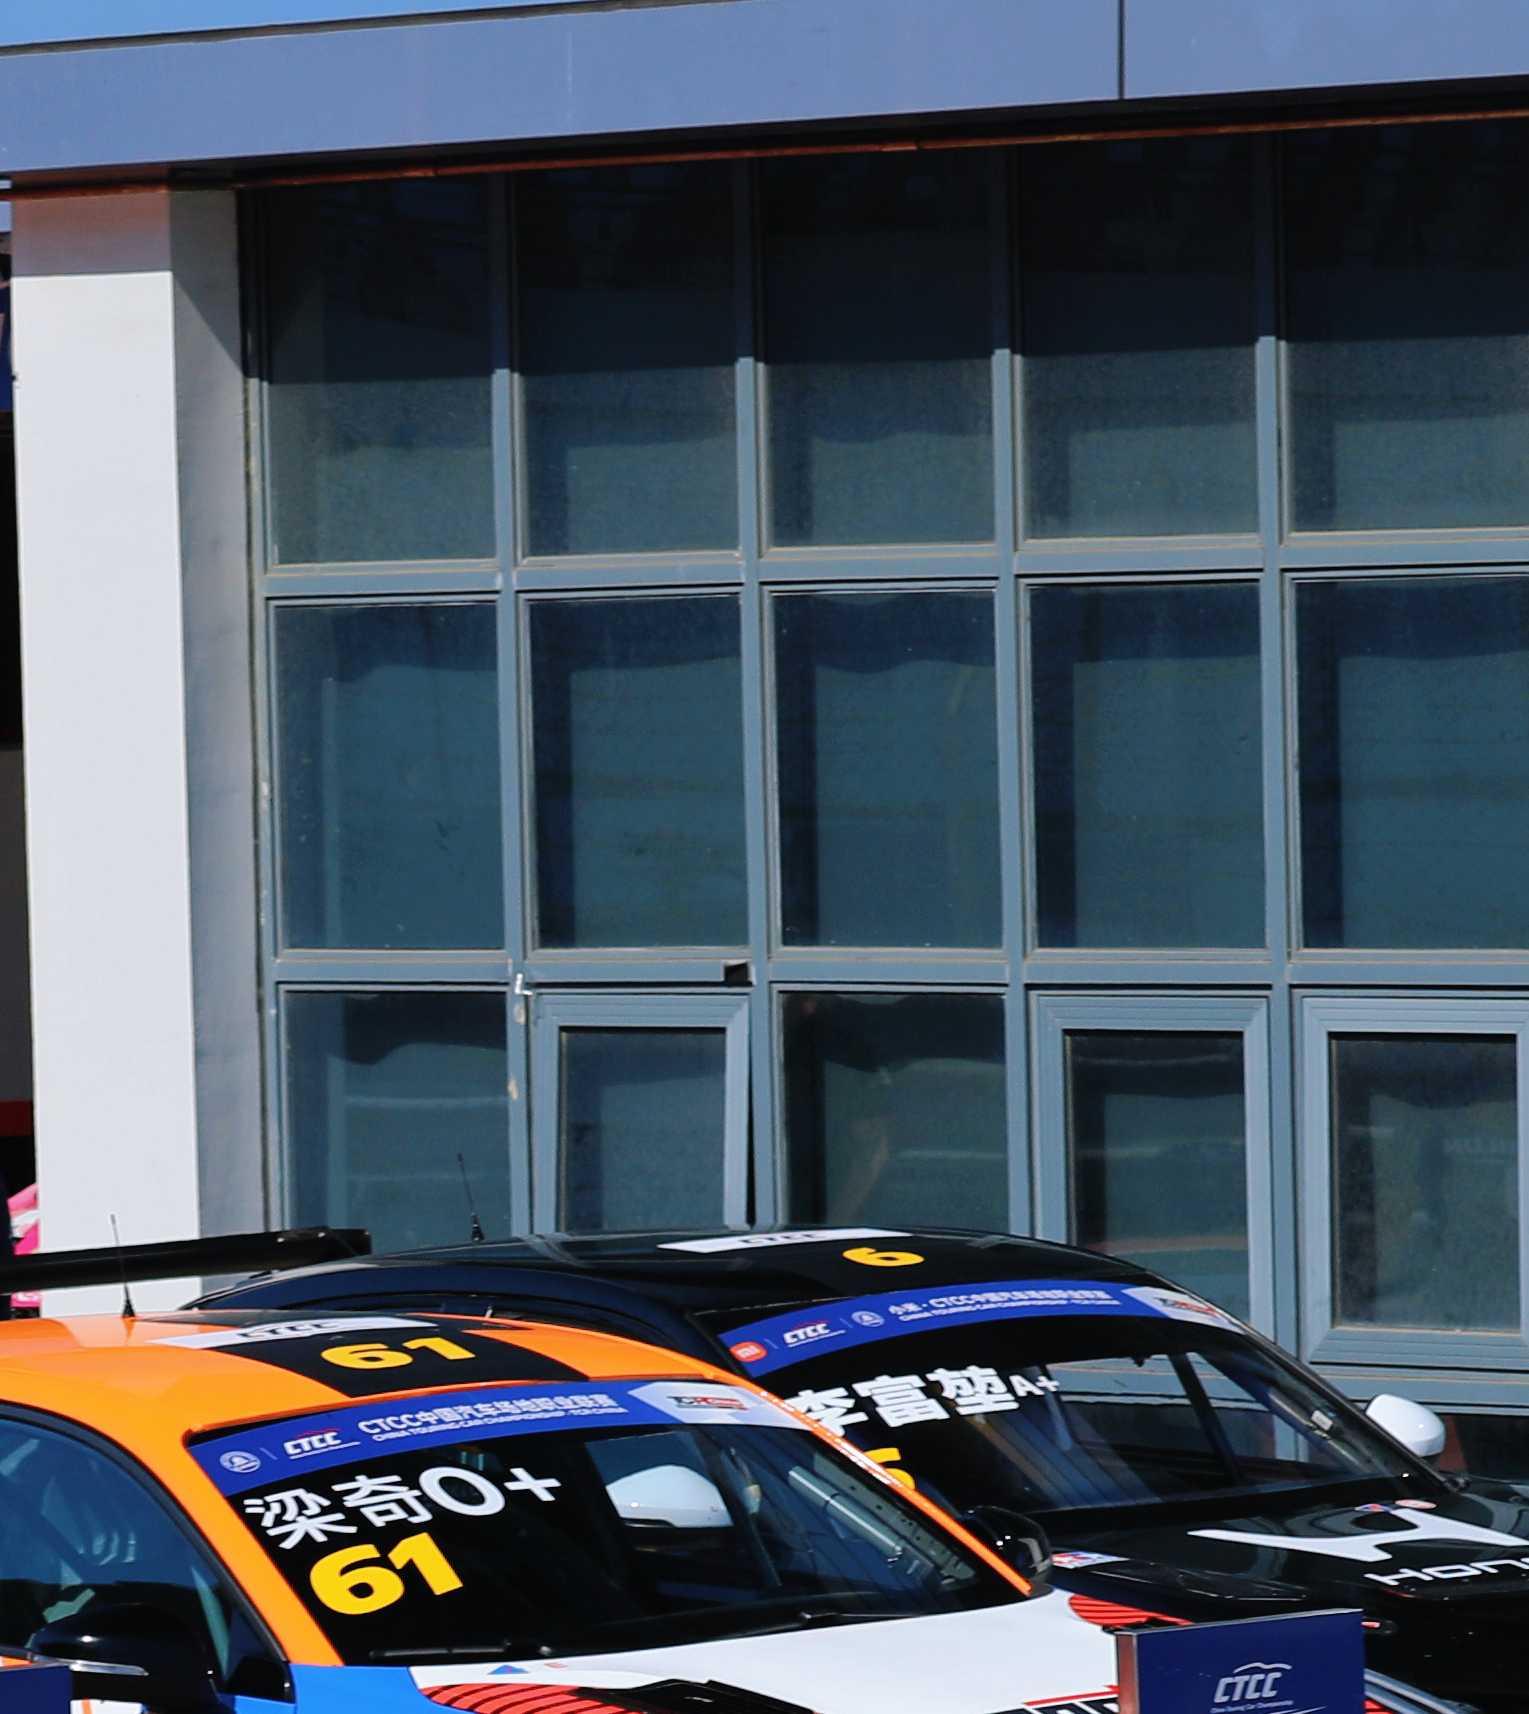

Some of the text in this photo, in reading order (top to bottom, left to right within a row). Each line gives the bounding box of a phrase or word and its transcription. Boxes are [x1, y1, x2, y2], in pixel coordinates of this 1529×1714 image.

[842, 1247, 925, 1267] 6
[320, 1337, 476, 1370] 61
[283, 1431, 343, 1456] CTCC
[309, 1531, 465, 1616] 61
[1213, 1671, 1283, 1704] CTCC
